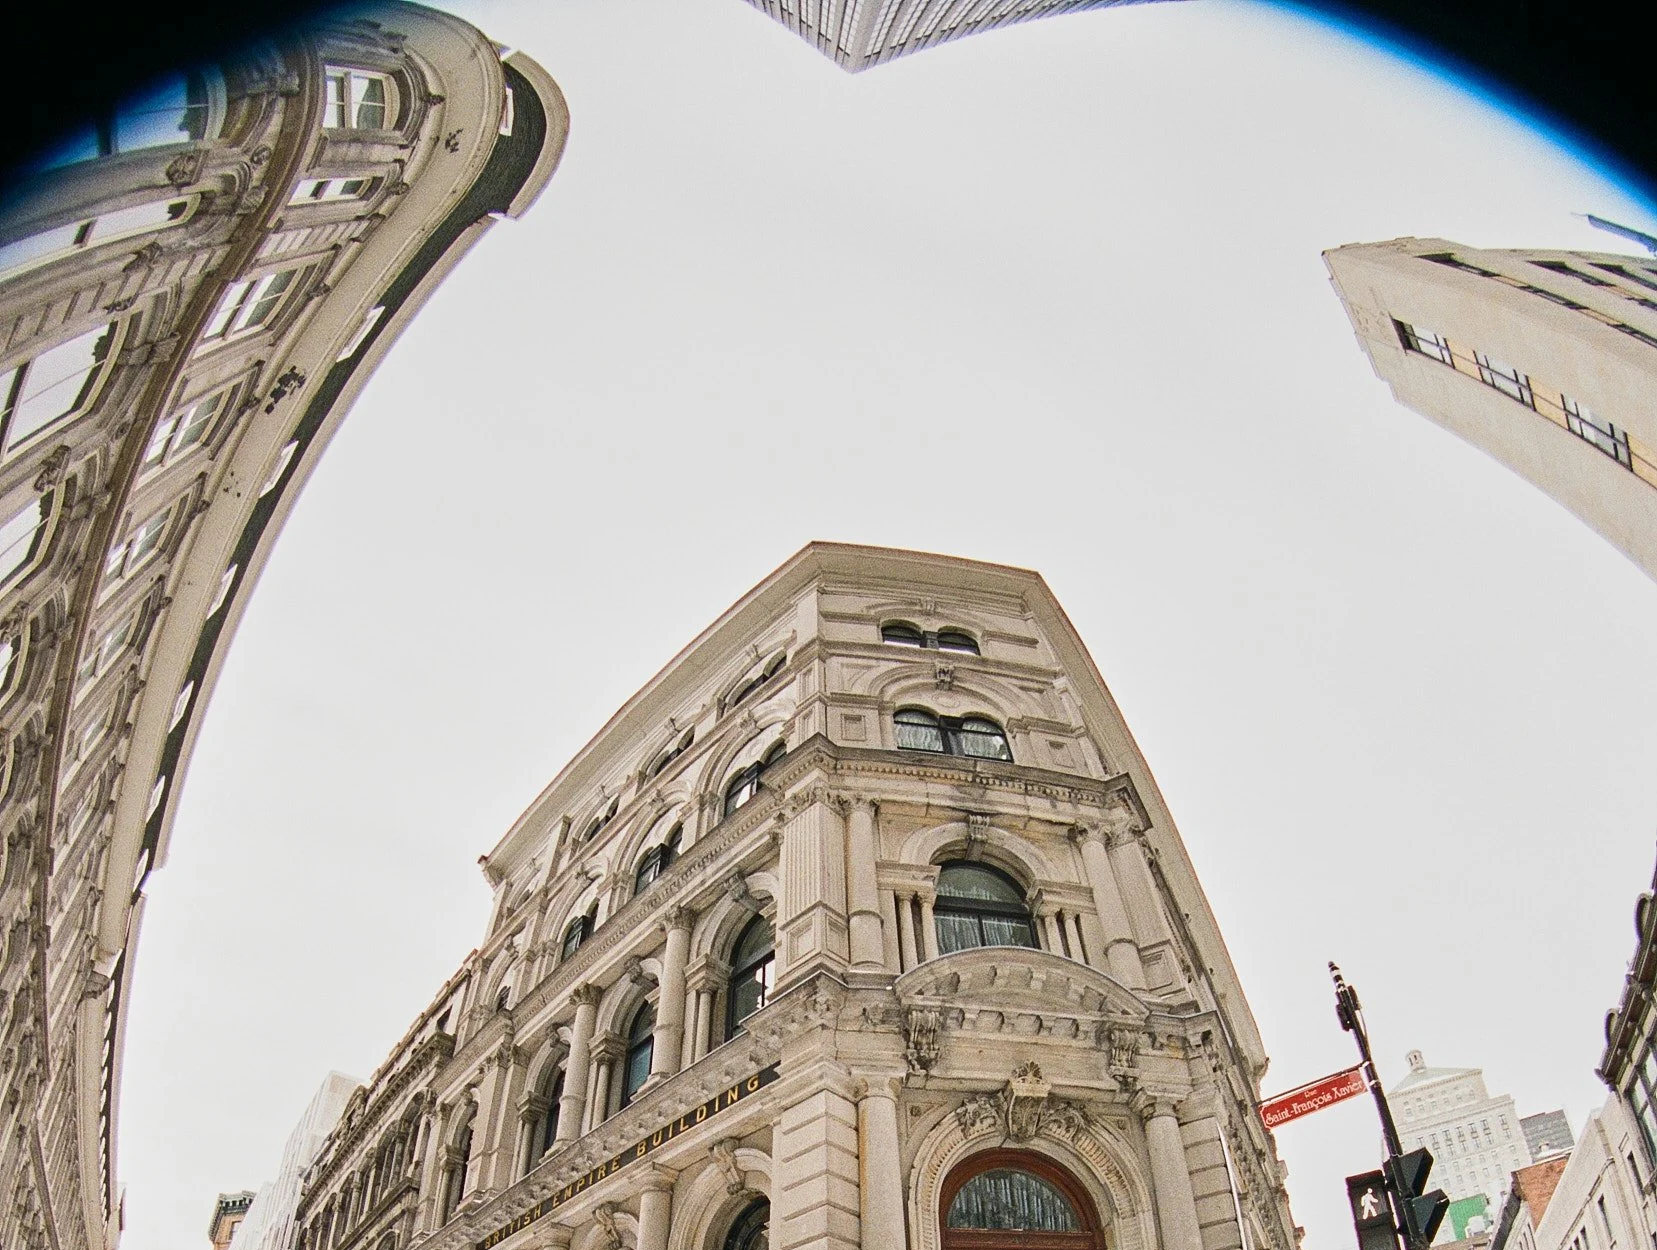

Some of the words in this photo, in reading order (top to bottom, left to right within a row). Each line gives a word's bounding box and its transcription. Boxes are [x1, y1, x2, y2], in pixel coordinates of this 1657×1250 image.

[1265, 1091, 1333, 1125] Saint-François
[1332, 1080, 1363, 1099] Xavier
[485, 1203, 542, 1249] BRITISH
[552, 1156, 621, 1207] EMPIRE
[636, 1075, 759, 1157] BUILDING
